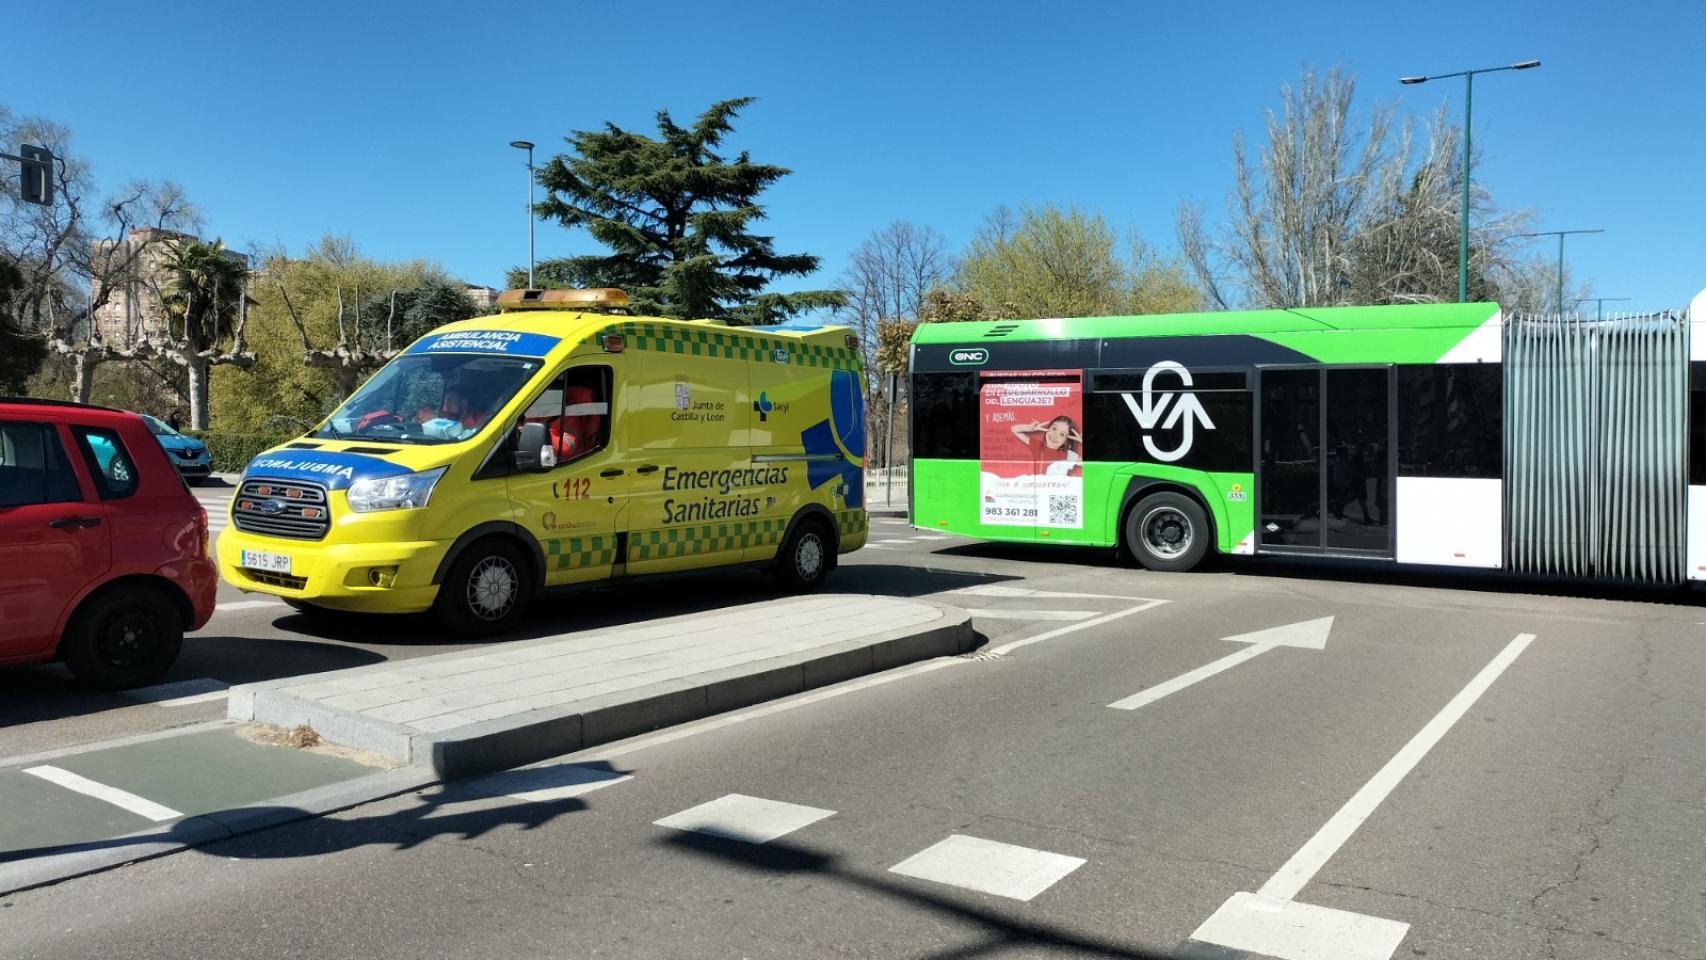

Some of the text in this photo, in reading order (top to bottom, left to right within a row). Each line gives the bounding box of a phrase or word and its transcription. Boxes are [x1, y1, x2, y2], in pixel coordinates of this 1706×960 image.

[437, 332, 521, 342] AMBULANCIA
[427, 340, 509, 351] ASISTENCIAL
[954, 352, 983, 361] GNC
[692, 400, 724, 410] Junta de
[672, 411, 724, 423] Castilla y León
[662, 465, 788, 495] Emergencias
[563, 477, 591, 500] 112
[662, 494, 761, 525] Sanitarias
[985, 507, 1039, 517] 983 361 281
[247, 551, 289, 568] 5615 JRP
